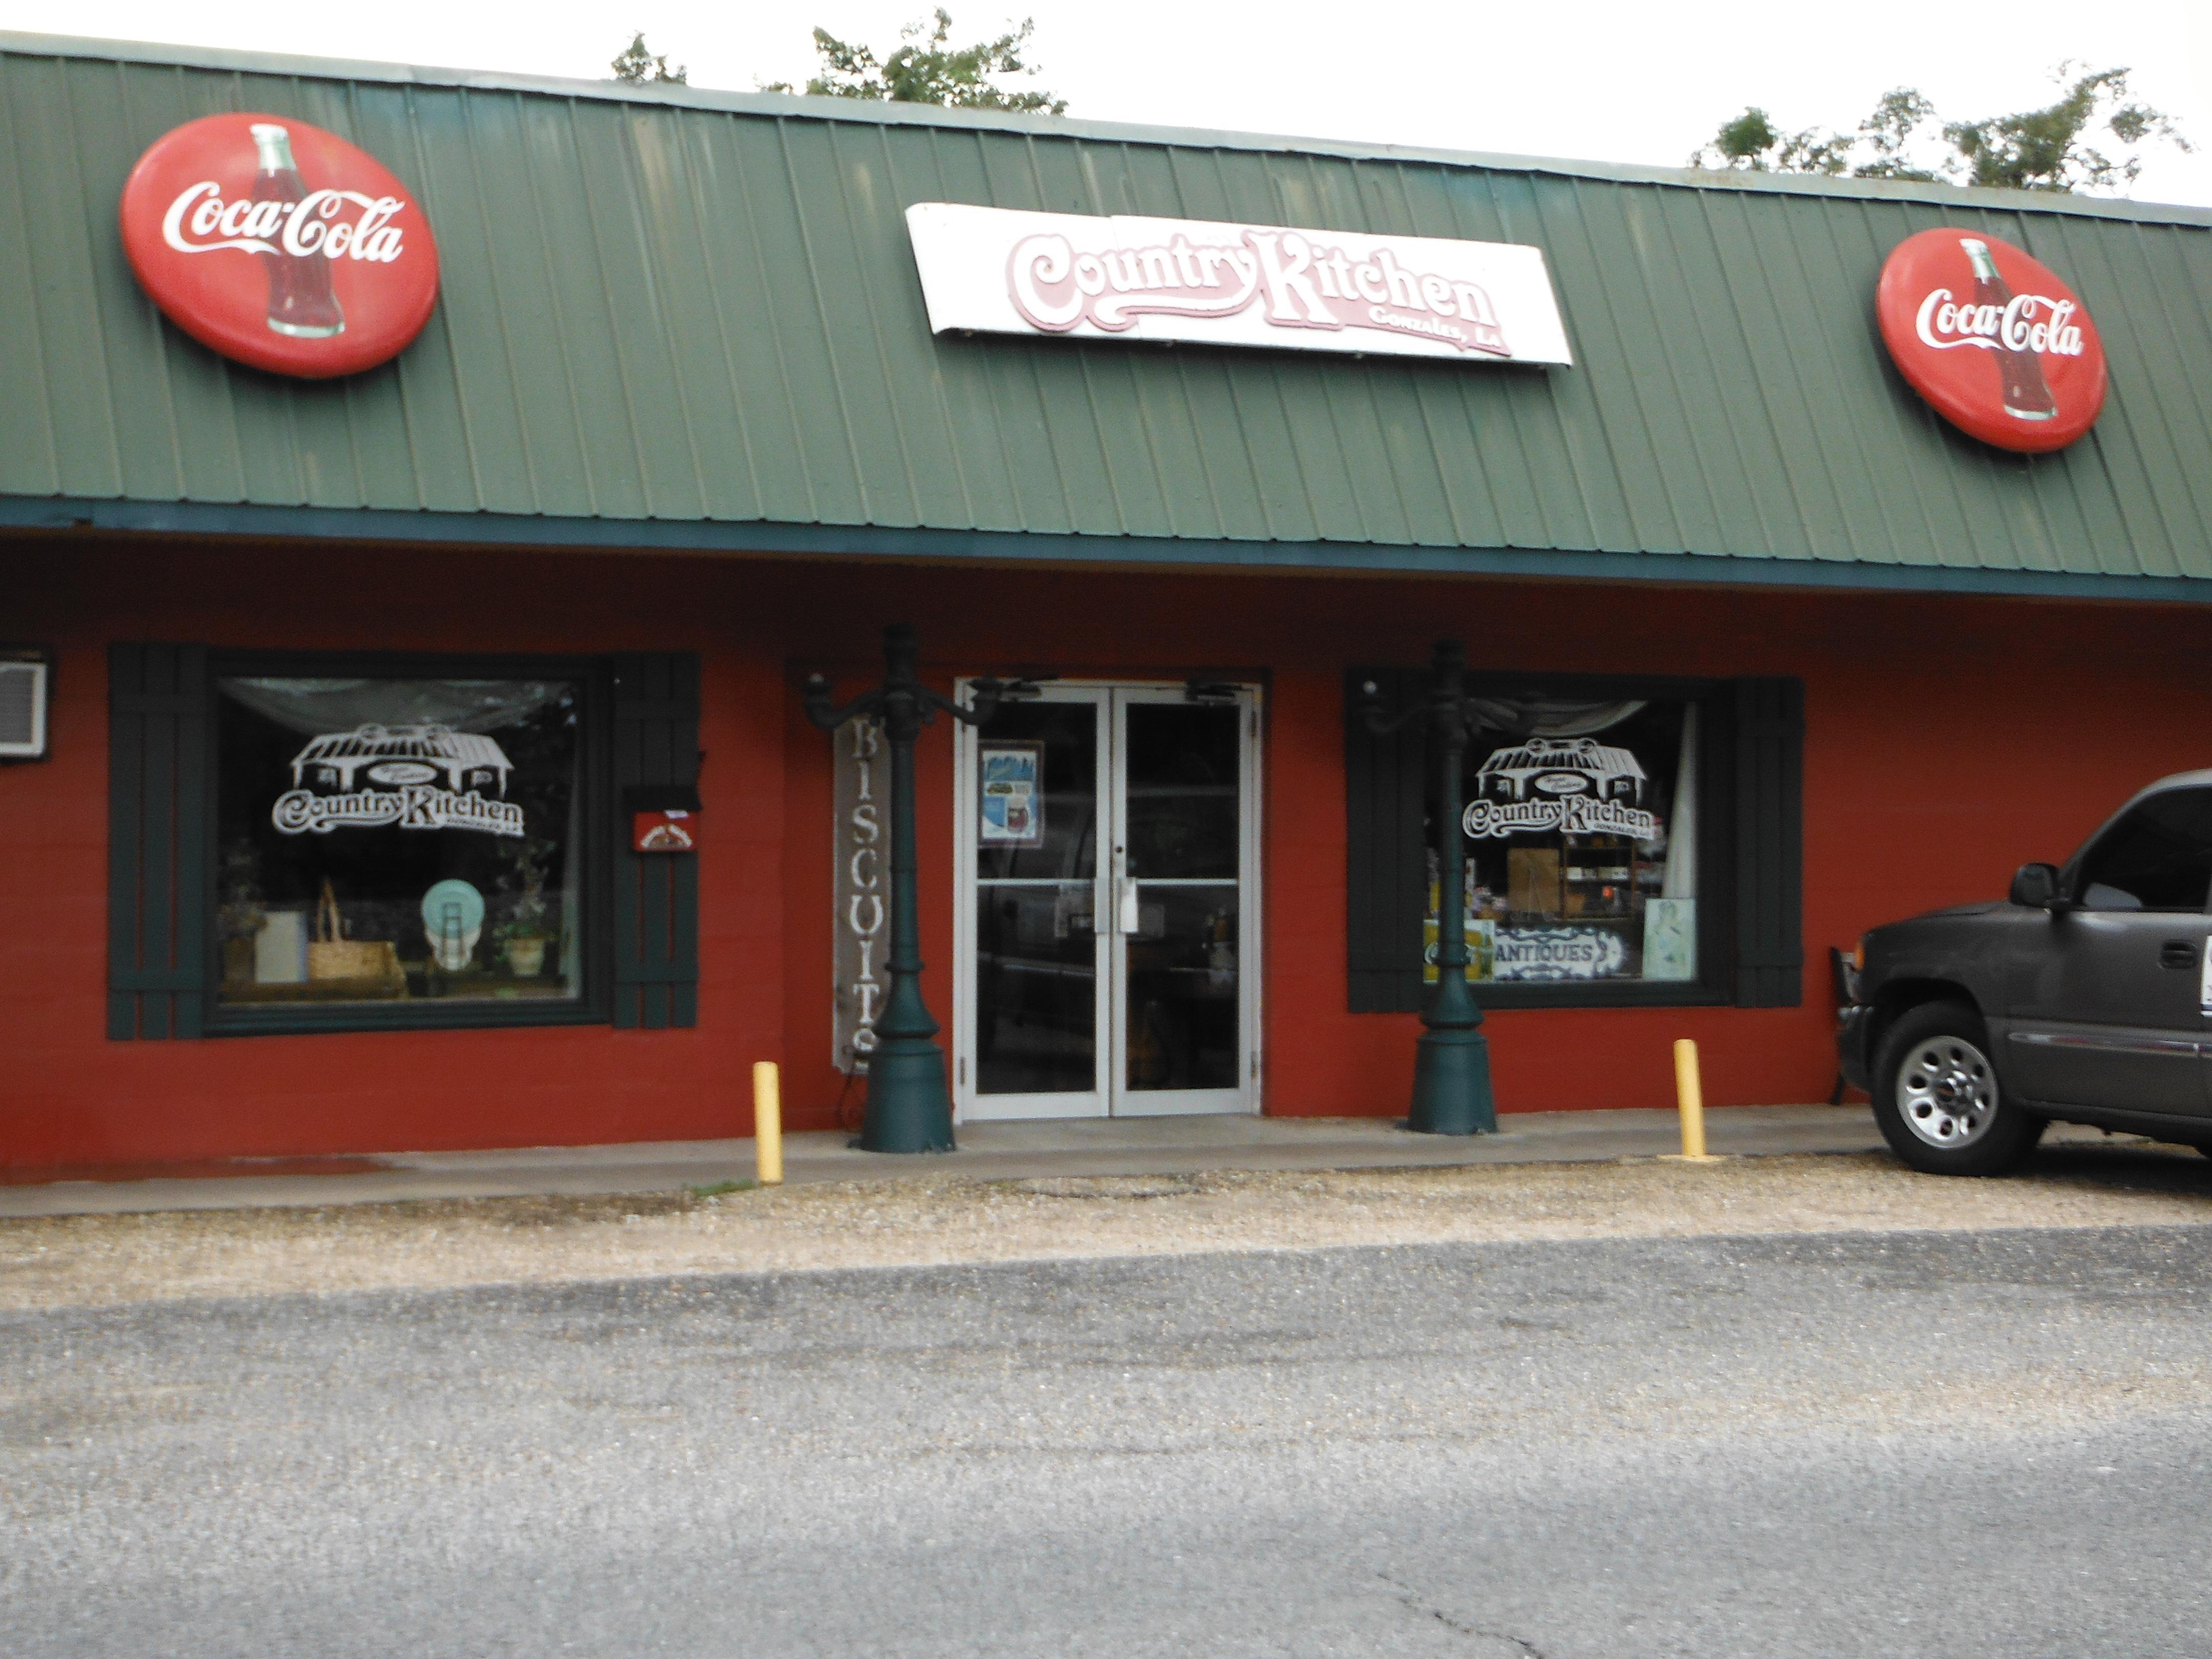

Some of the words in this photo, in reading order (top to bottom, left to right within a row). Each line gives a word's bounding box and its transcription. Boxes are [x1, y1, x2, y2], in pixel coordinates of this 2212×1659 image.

[1013, 233, 1258, 325] Country
[1246, 231, 1497, 328] Kitchen
[1475, 326, 1502, 347] LA
[271, 789, 404, 834] Country
[402, 787, 522, 826] Kitchen
[1462, 797, 1563, 838] Country
[1561, 795, 1652, 832] Kitchen
[1495, 943, 1593, 963] ANTIQUES
